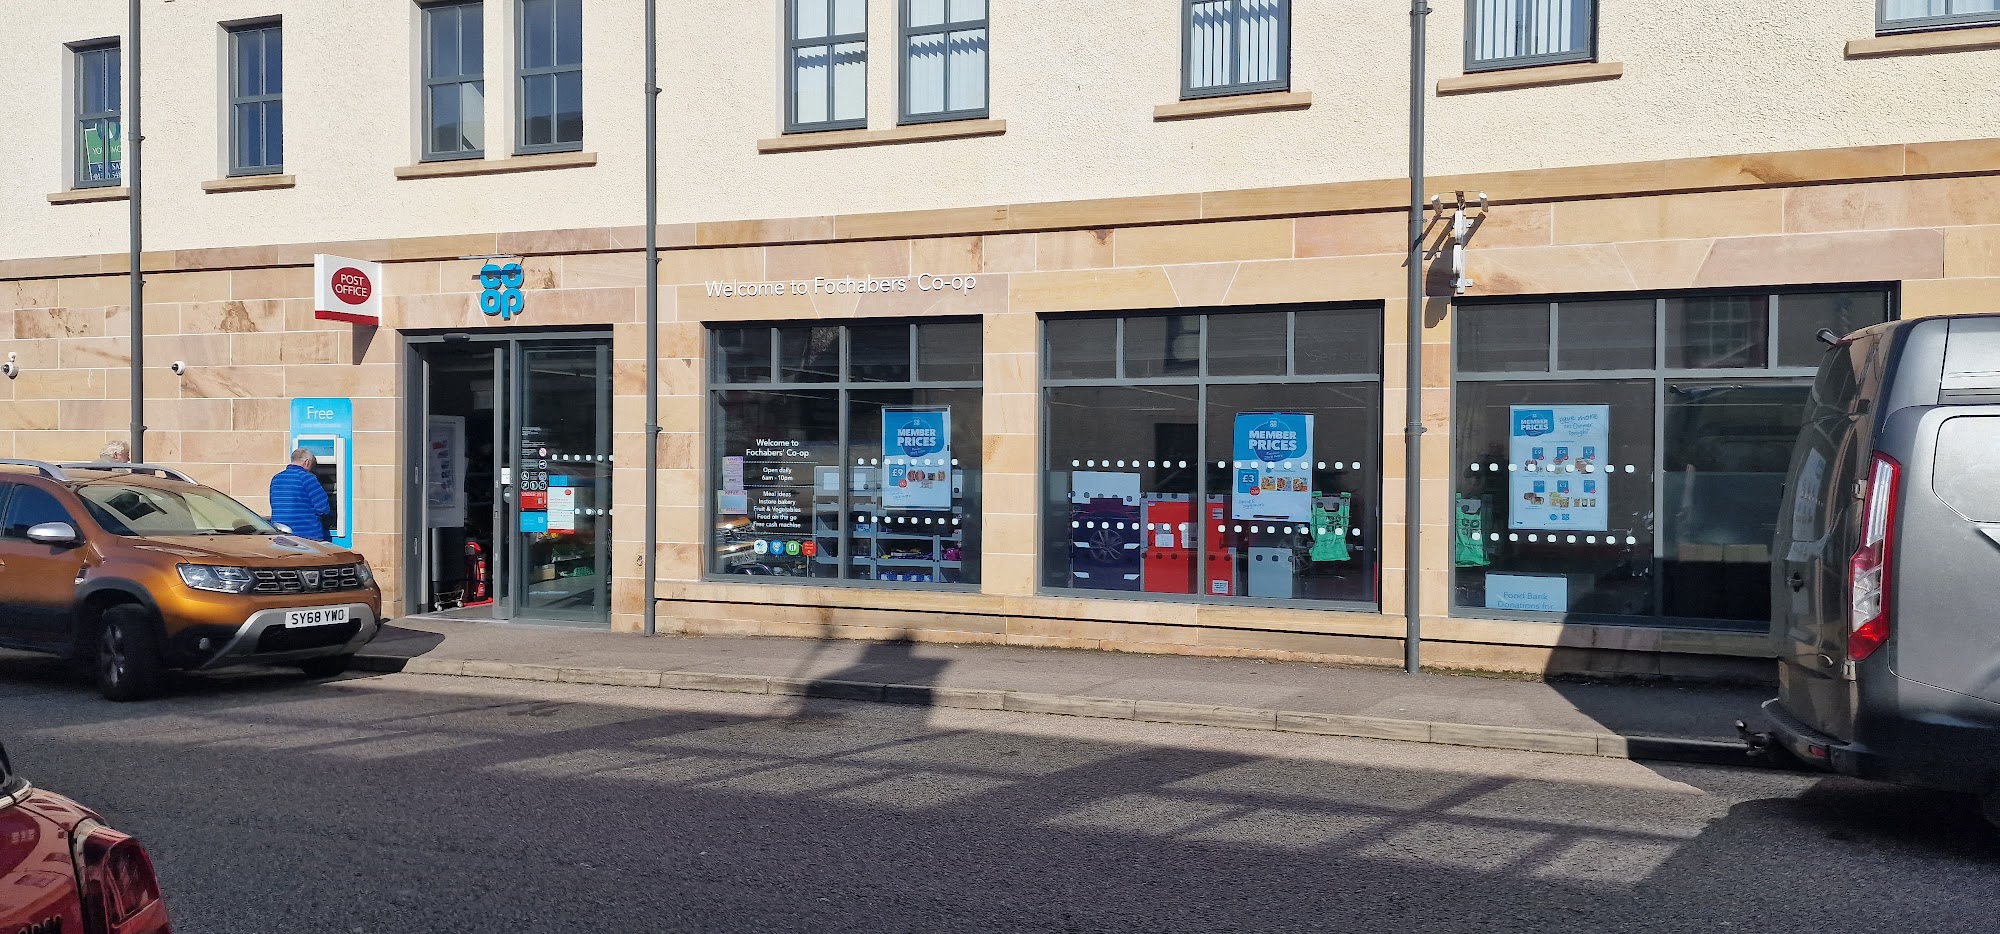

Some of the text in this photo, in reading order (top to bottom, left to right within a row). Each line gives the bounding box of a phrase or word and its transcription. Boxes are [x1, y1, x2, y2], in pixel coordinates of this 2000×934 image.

[340, 273, 365, 286] POST
[335, 283, 367, 297] OFFICE
[704, 273, 977, 298] Welcome to Fochabers' Co-op
[306, 406, 334, 419] Free
[1577, 413, 1598, 421] more
[1520, 418, 1549, 426] MEMBER
[897, 428, 936, 437] MEMBER
[1248, 430, 1297, 439] MEMBER
[756, 439, 790, 447] Welcome
[897, 437, 937, 447] PRICES
[1248, 439, 1298, 451] PRICES
[746, 449, 810, 458] Fochabers' Co-op
[762, 467, 792, 475] Open daily
[891, 468, 904, 477] £9
[1242, 474, 1255, 483] £3
[777, 498, 796, 506] bakery
[771, 506, 801, 514] Vegetables
[1503, 591, 1548, 600] Food Bank
[1497, 601, 1555, 610] Donations for
[291, 609, 344, 625] SY68 YWO
